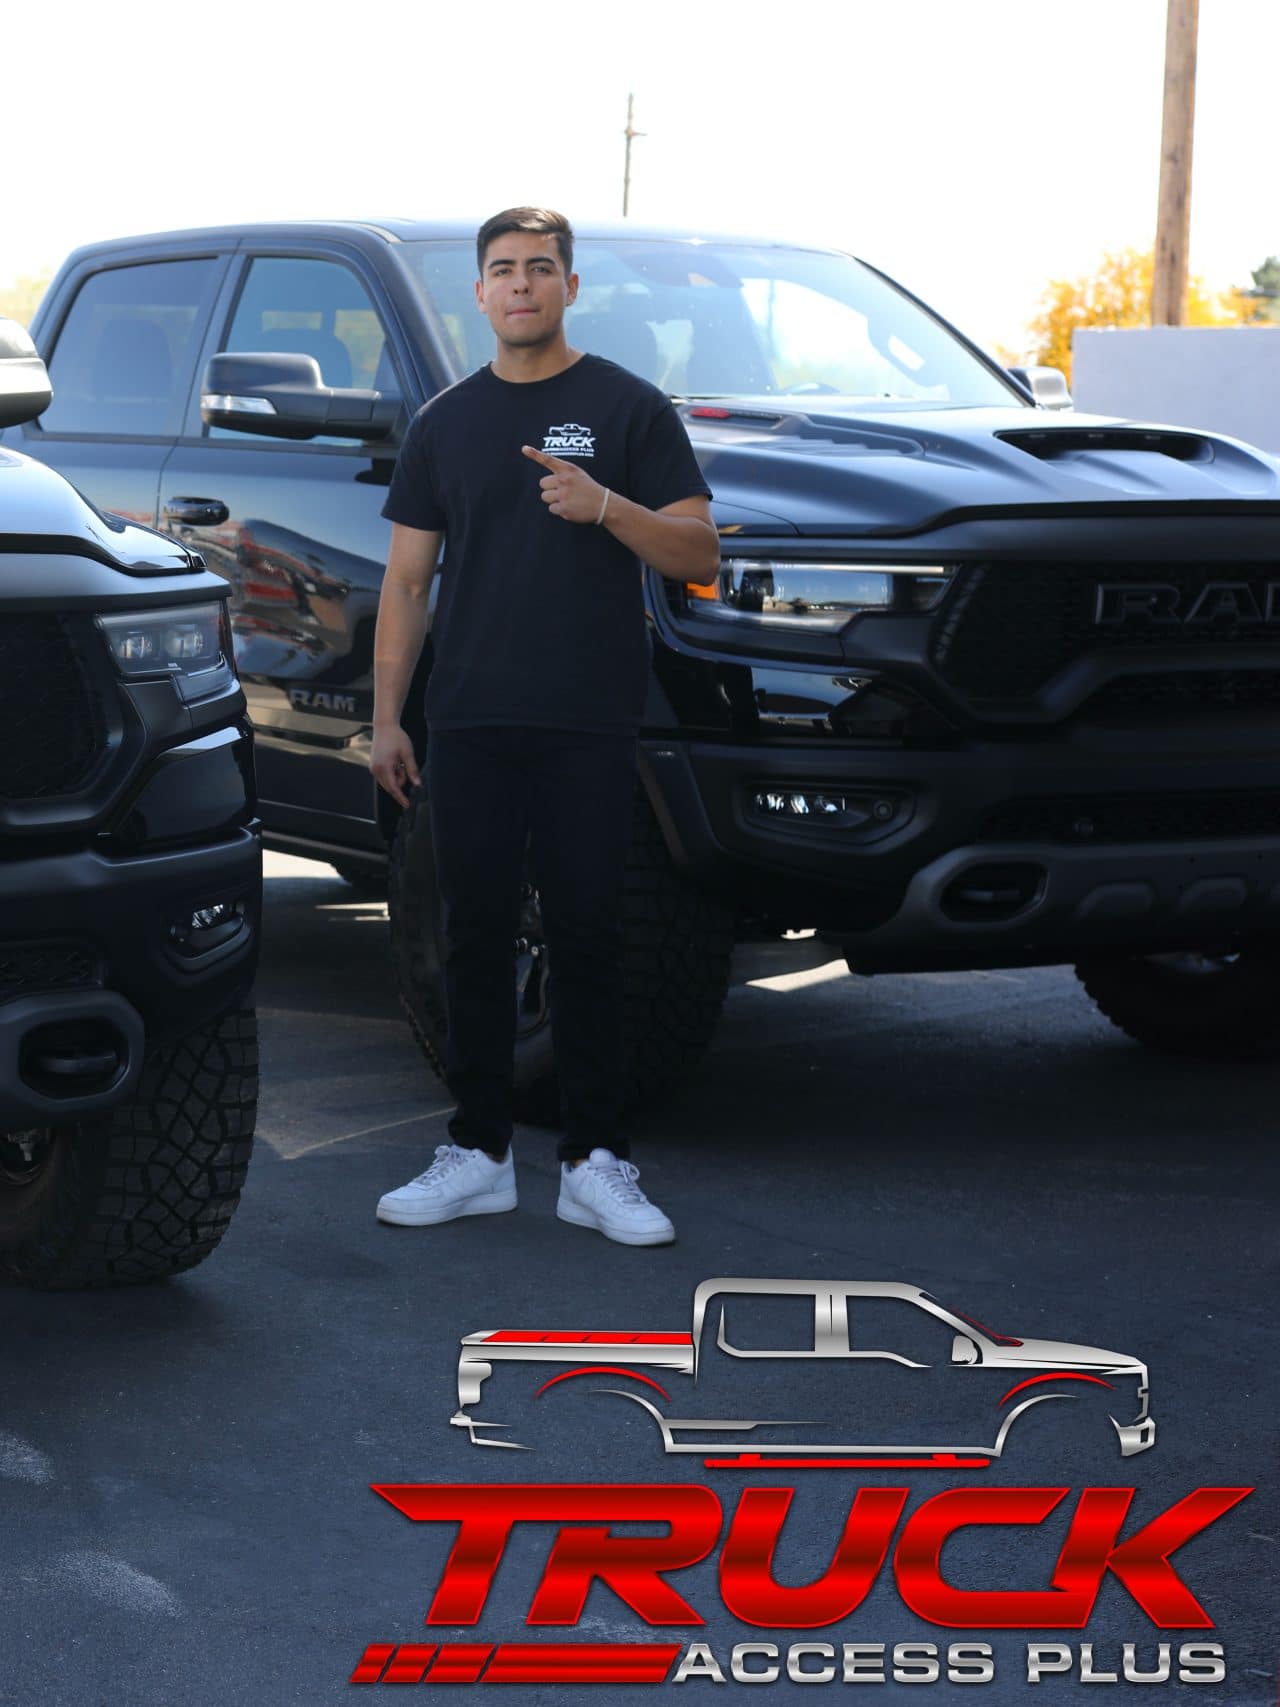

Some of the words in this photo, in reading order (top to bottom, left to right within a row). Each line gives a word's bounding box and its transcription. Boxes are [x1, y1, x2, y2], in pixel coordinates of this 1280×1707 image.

[542, 436, 596, 448] TRUCK
[1093, 583, 1280, 625] RA
[290, 688, 354, 713] RAM
